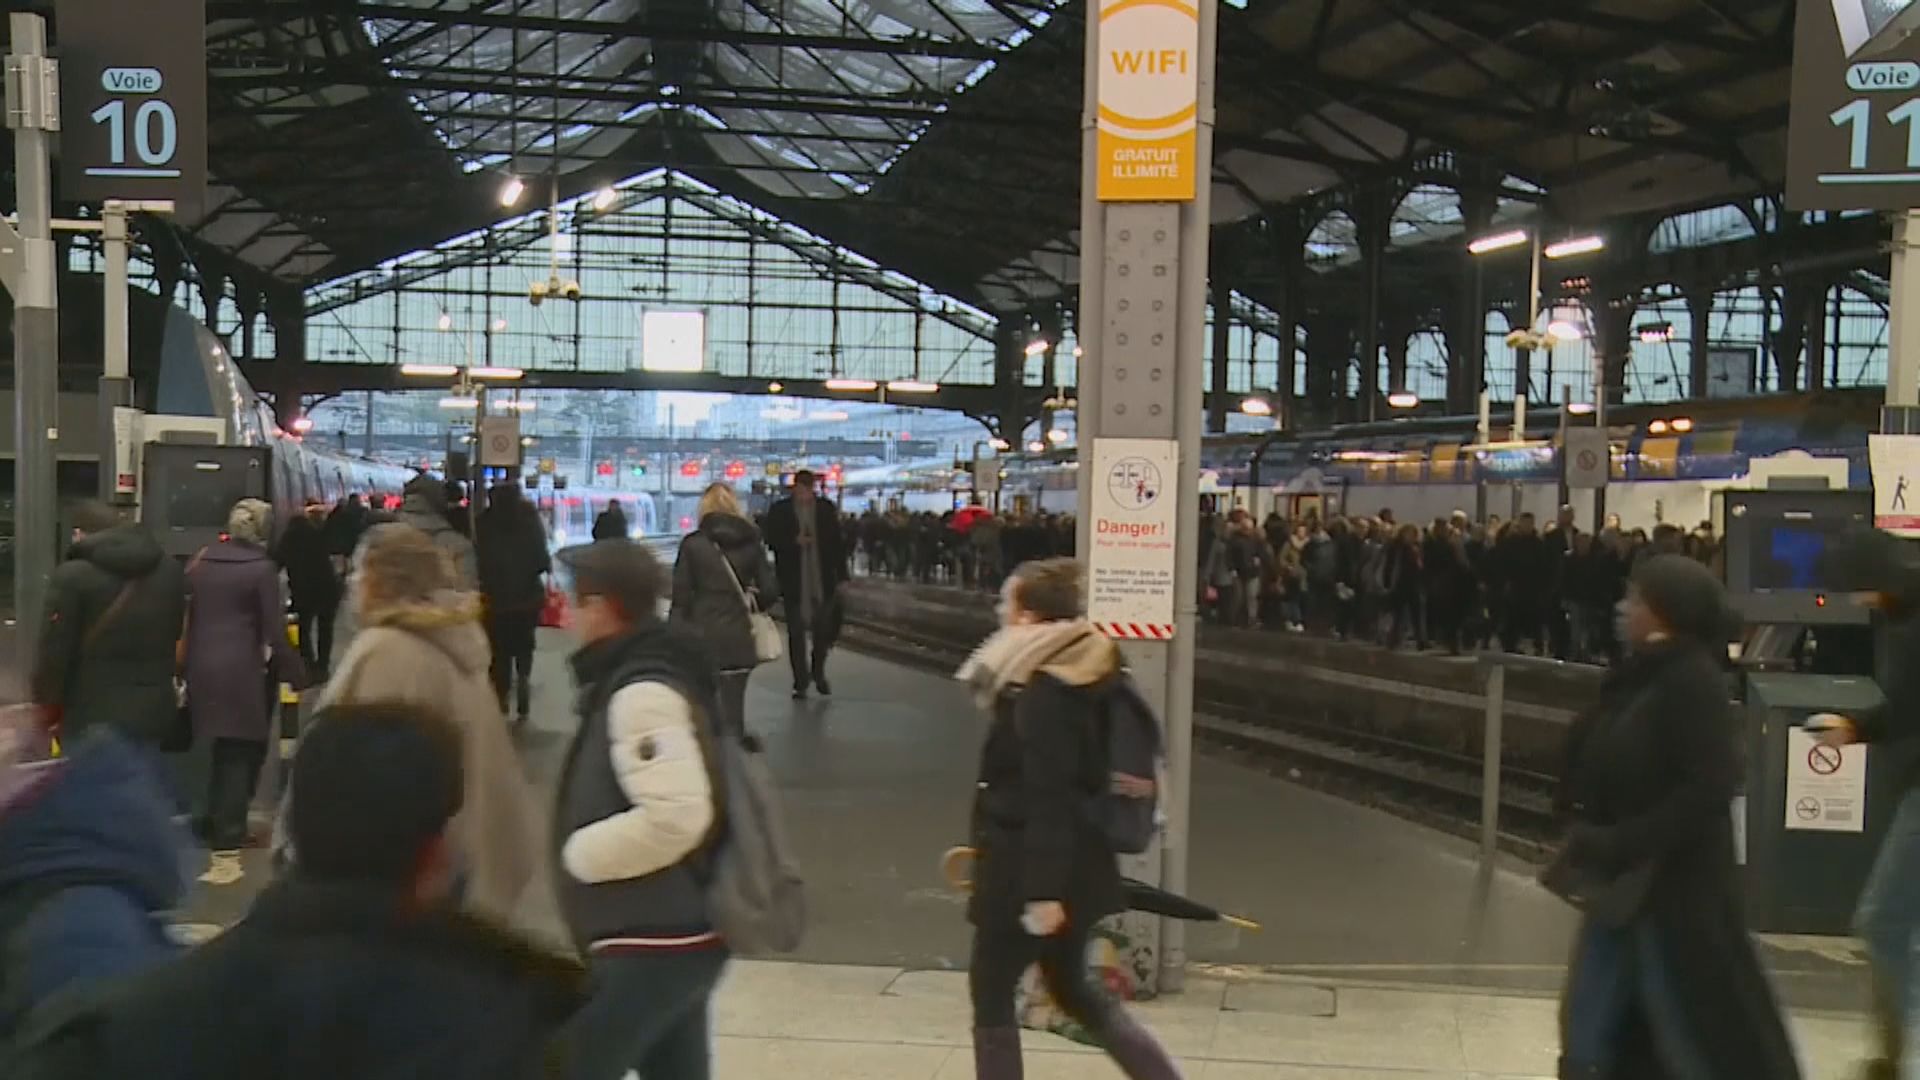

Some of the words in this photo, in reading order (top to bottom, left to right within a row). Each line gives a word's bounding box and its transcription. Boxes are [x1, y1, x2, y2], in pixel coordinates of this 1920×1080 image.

[1112, 50, 1188, 75] WIFI
[109, 71, 154, 90] Voie
[1855, 65, 1910, 86] Voie
[91, 99, 178, 165] 10
[1829, 97, 1920, 169] 11
[1113, 149, 1178, 162] GRATUIT
[1112, 162, 1178, 178] ILLIMITÉ
